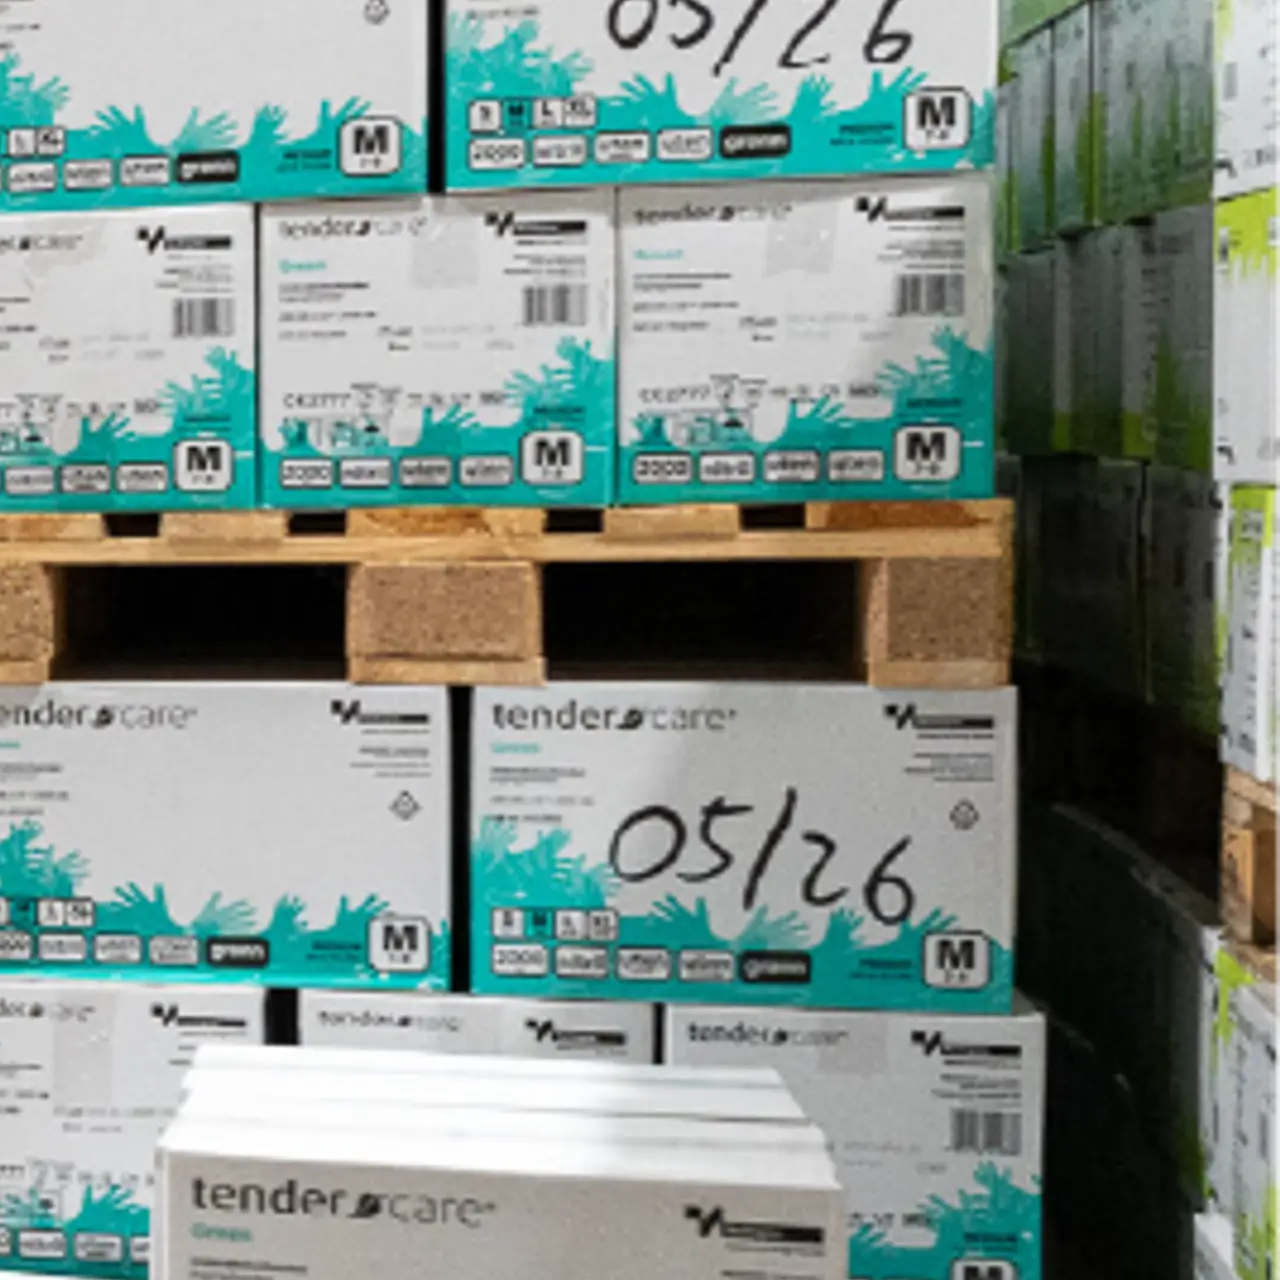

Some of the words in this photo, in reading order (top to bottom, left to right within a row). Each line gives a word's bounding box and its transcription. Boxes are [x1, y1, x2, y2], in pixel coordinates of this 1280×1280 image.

[919, 97, 955, 128] M
[354, 126, 387, 154] M
[187, 446, 221, 471] M
[536, 439, 569, 466] M
[907, 432, 945, 460] M
[492, 699, 616, 731] tender
[609, 788, 915, 926] 05/26
[383, 925, 417, 951] M
[938, 939, 975, 969] M
[193, 1178, 345, 1215] tender
[388, 1193, 483, 1229] care
